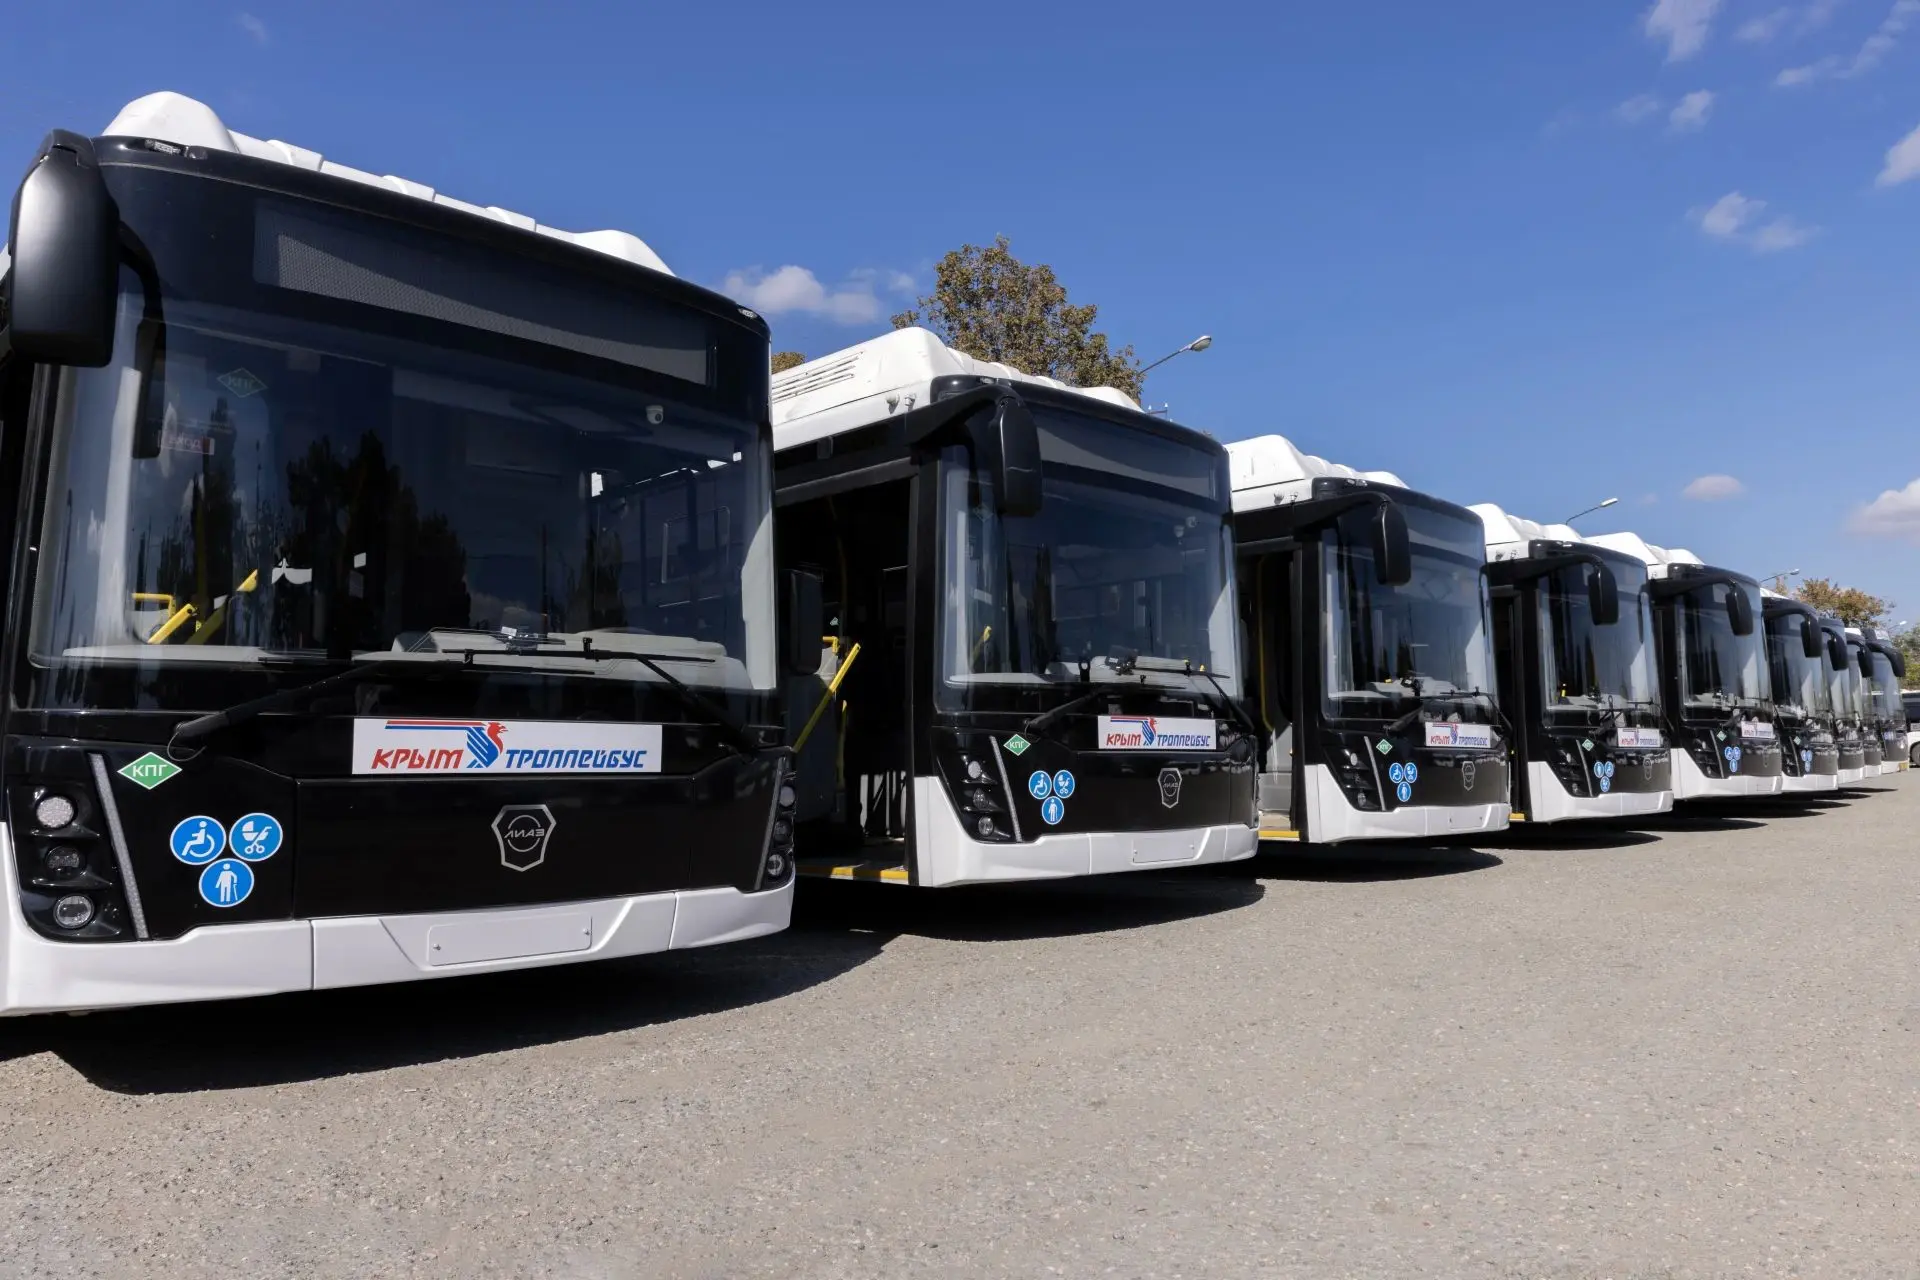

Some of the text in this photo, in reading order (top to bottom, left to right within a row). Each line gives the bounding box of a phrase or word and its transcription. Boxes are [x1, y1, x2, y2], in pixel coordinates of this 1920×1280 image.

[1009, 741, 1025, 749] КПГ
[1106, 733, 1211, 746] КРЫМ ТРОЛЛЕЙБУС
[371, 748, 648, 769] КРЫМ ТРОЛЛЕЙБУС
[132, 764, 169, 777] КПГ
[503, 828, 545, 839] ЛИАЗ
